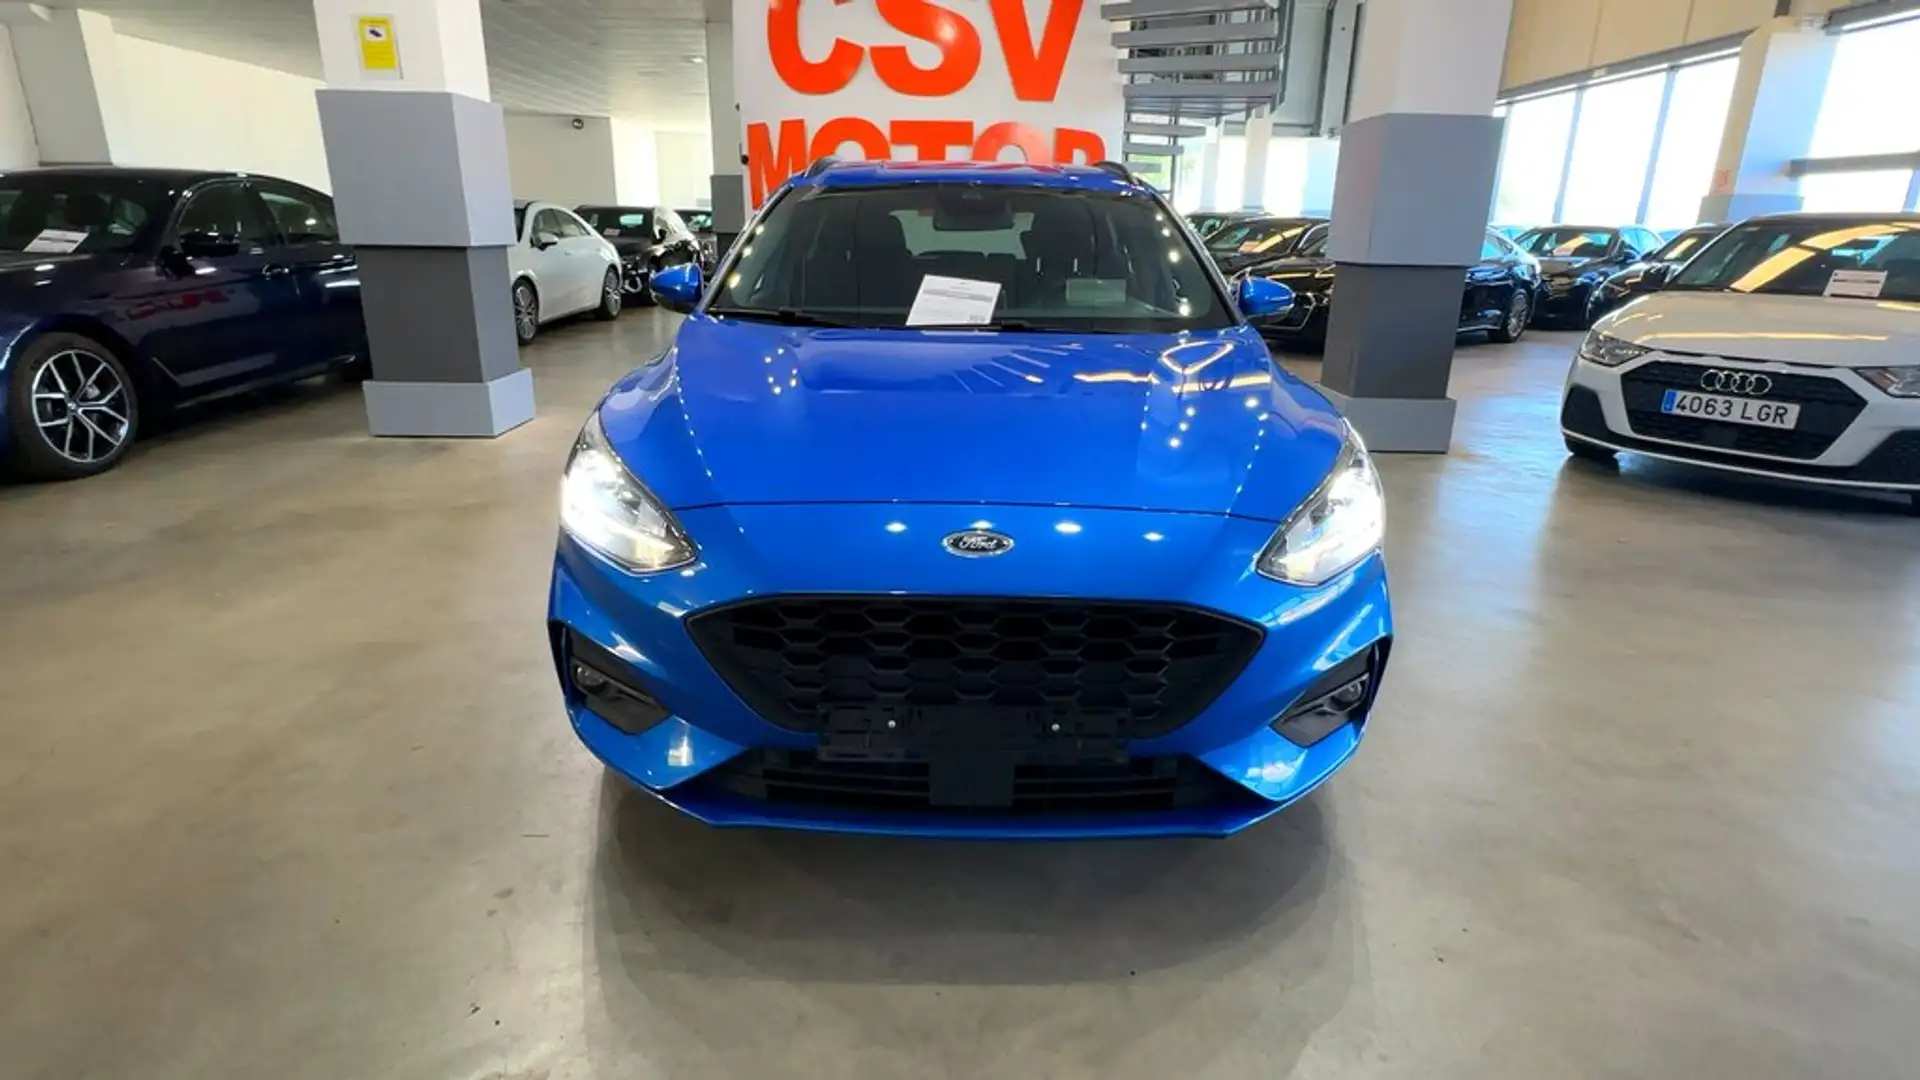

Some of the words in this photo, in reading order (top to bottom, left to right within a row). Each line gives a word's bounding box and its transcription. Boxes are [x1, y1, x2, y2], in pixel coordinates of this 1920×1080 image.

[767, 0, 1084, 102] CSV
[1676, 395, 1734, 418] 4063
[1739, 401, 1789, 425] LGR
[959, 535, 998, 550] Ford
